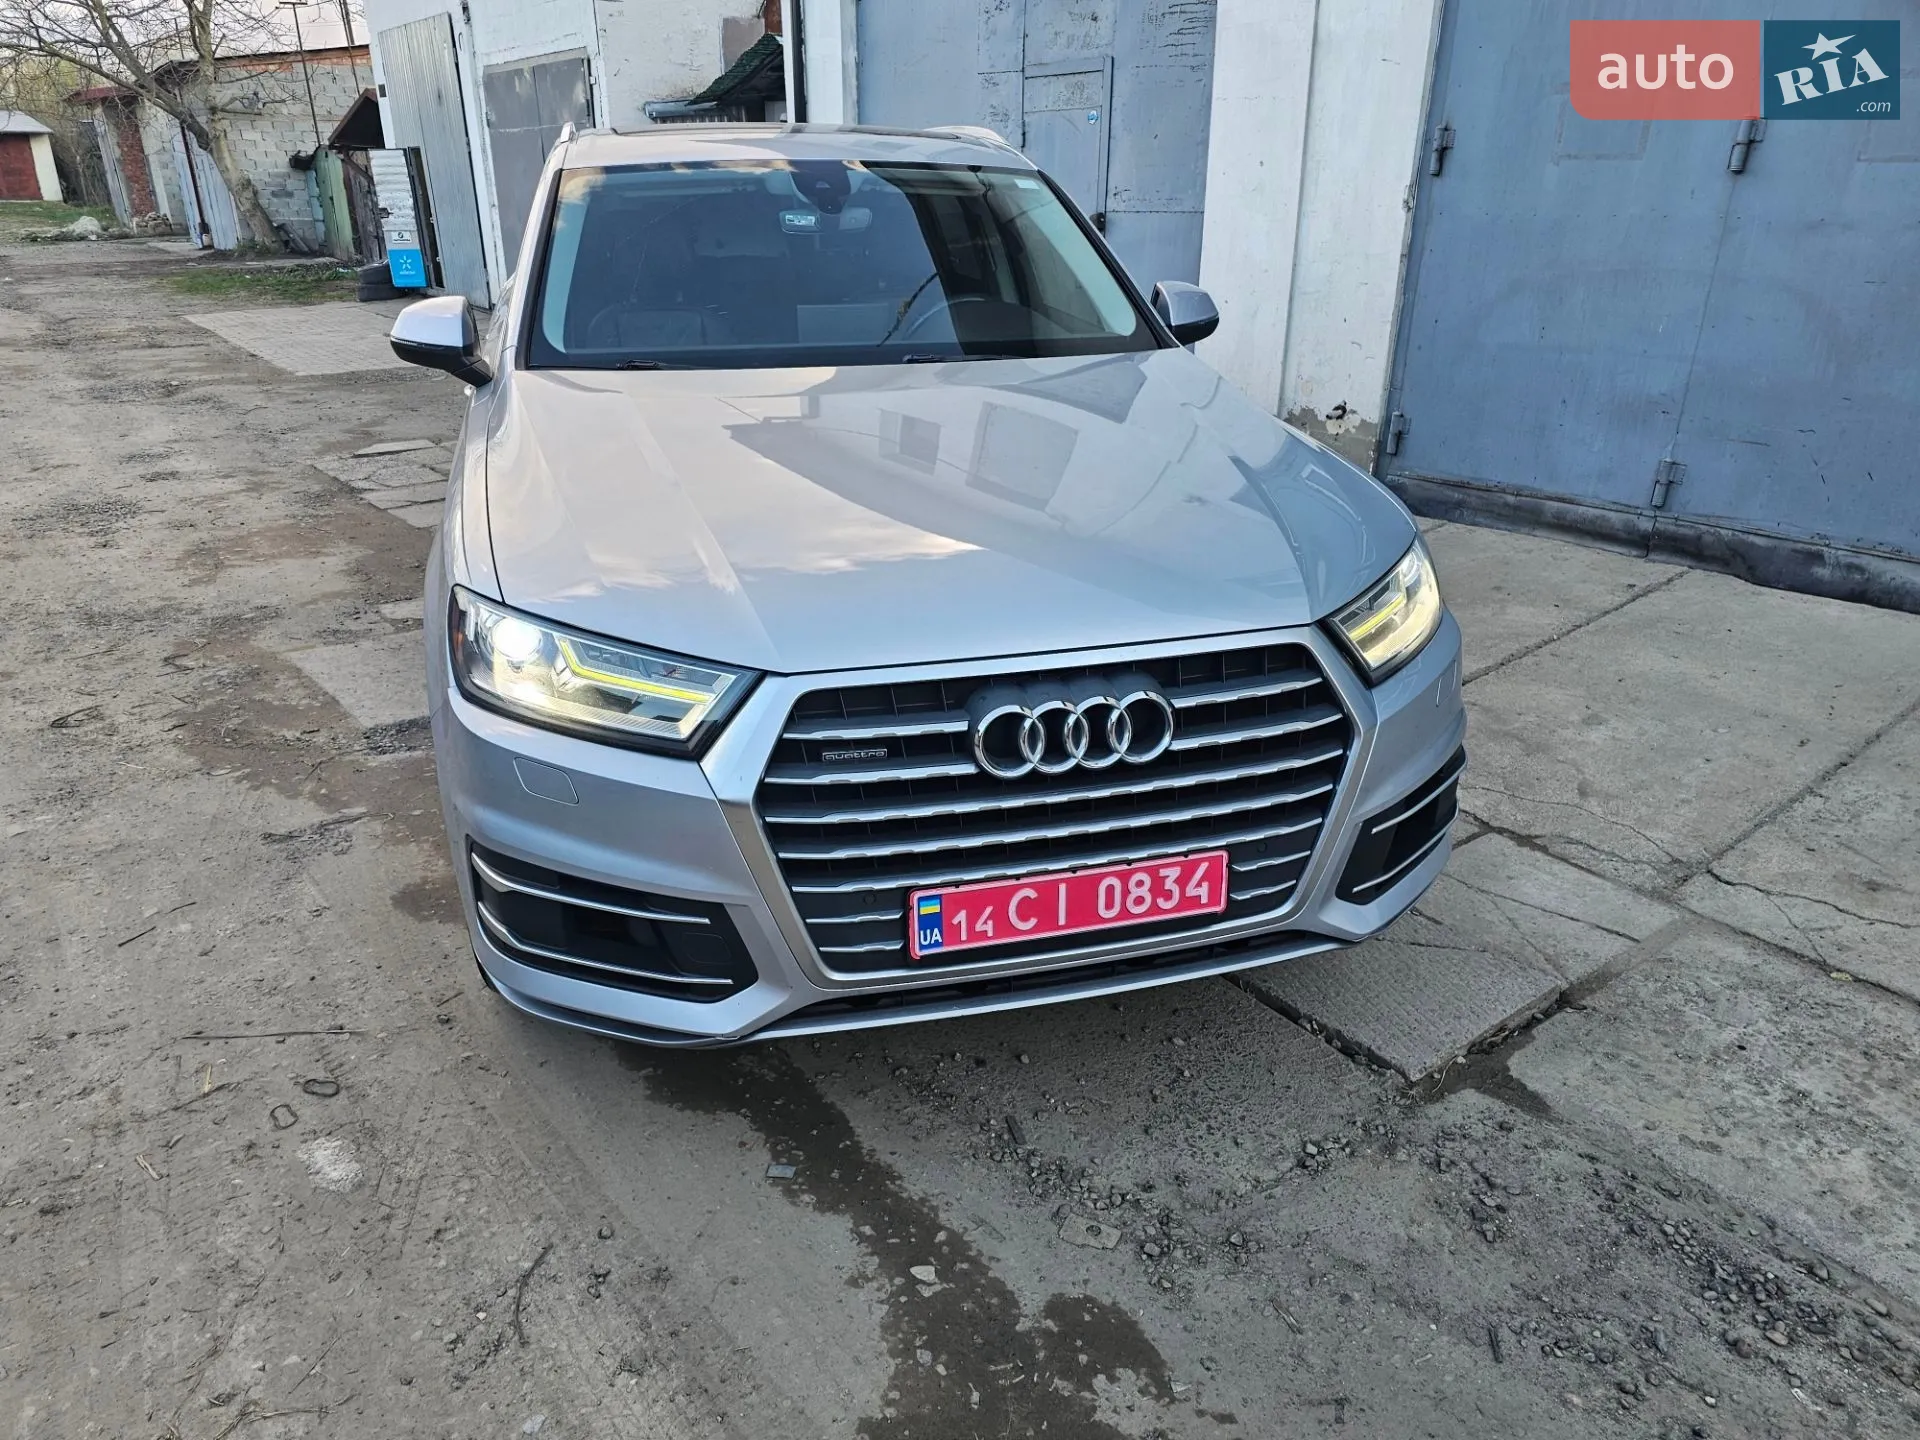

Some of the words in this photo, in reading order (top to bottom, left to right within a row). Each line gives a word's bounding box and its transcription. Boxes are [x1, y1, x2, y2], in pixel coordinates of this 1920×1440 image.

[825, 750, 885, 761] quattro
[1097, 861, 1211, 919] 0834
[919, 927, 943, 946] UA
